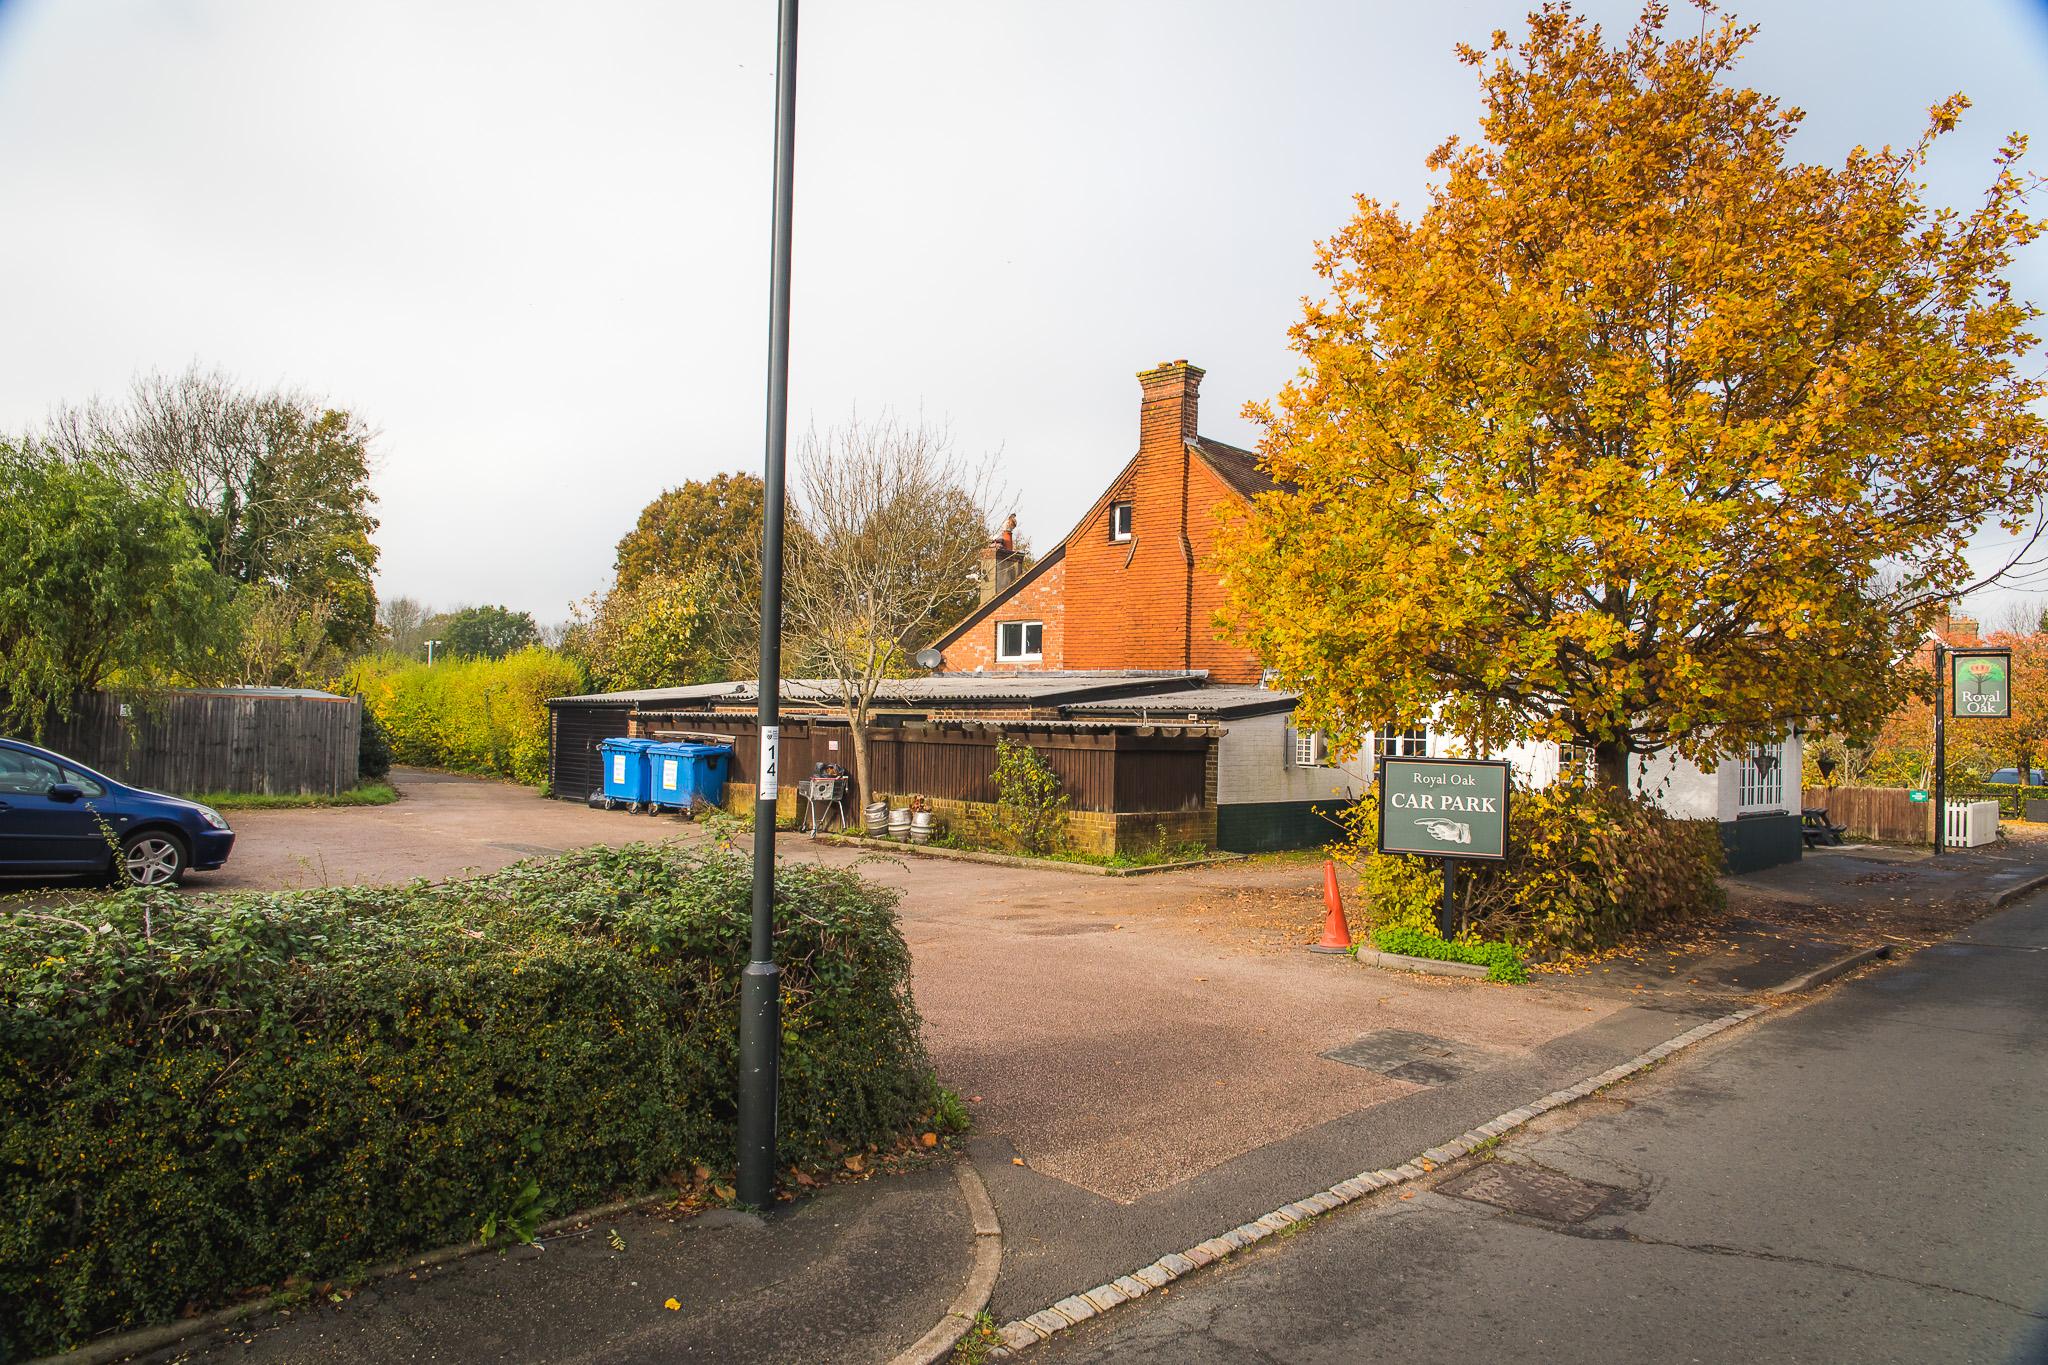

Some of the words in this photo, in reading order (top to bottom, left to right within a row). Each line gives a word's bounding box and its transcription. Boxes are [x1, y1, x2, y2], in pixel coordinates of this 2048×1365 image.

[1962, 690, 2000, 706] Royal
[1967, 701, 1996, 713] Oak
[1413, 772, 1446, 787] Royal
[1450, 774, 1476, 786] Oak
[1391, 792, 1434, 810] CAR
[1440, 795, 1497, 813] PARK
